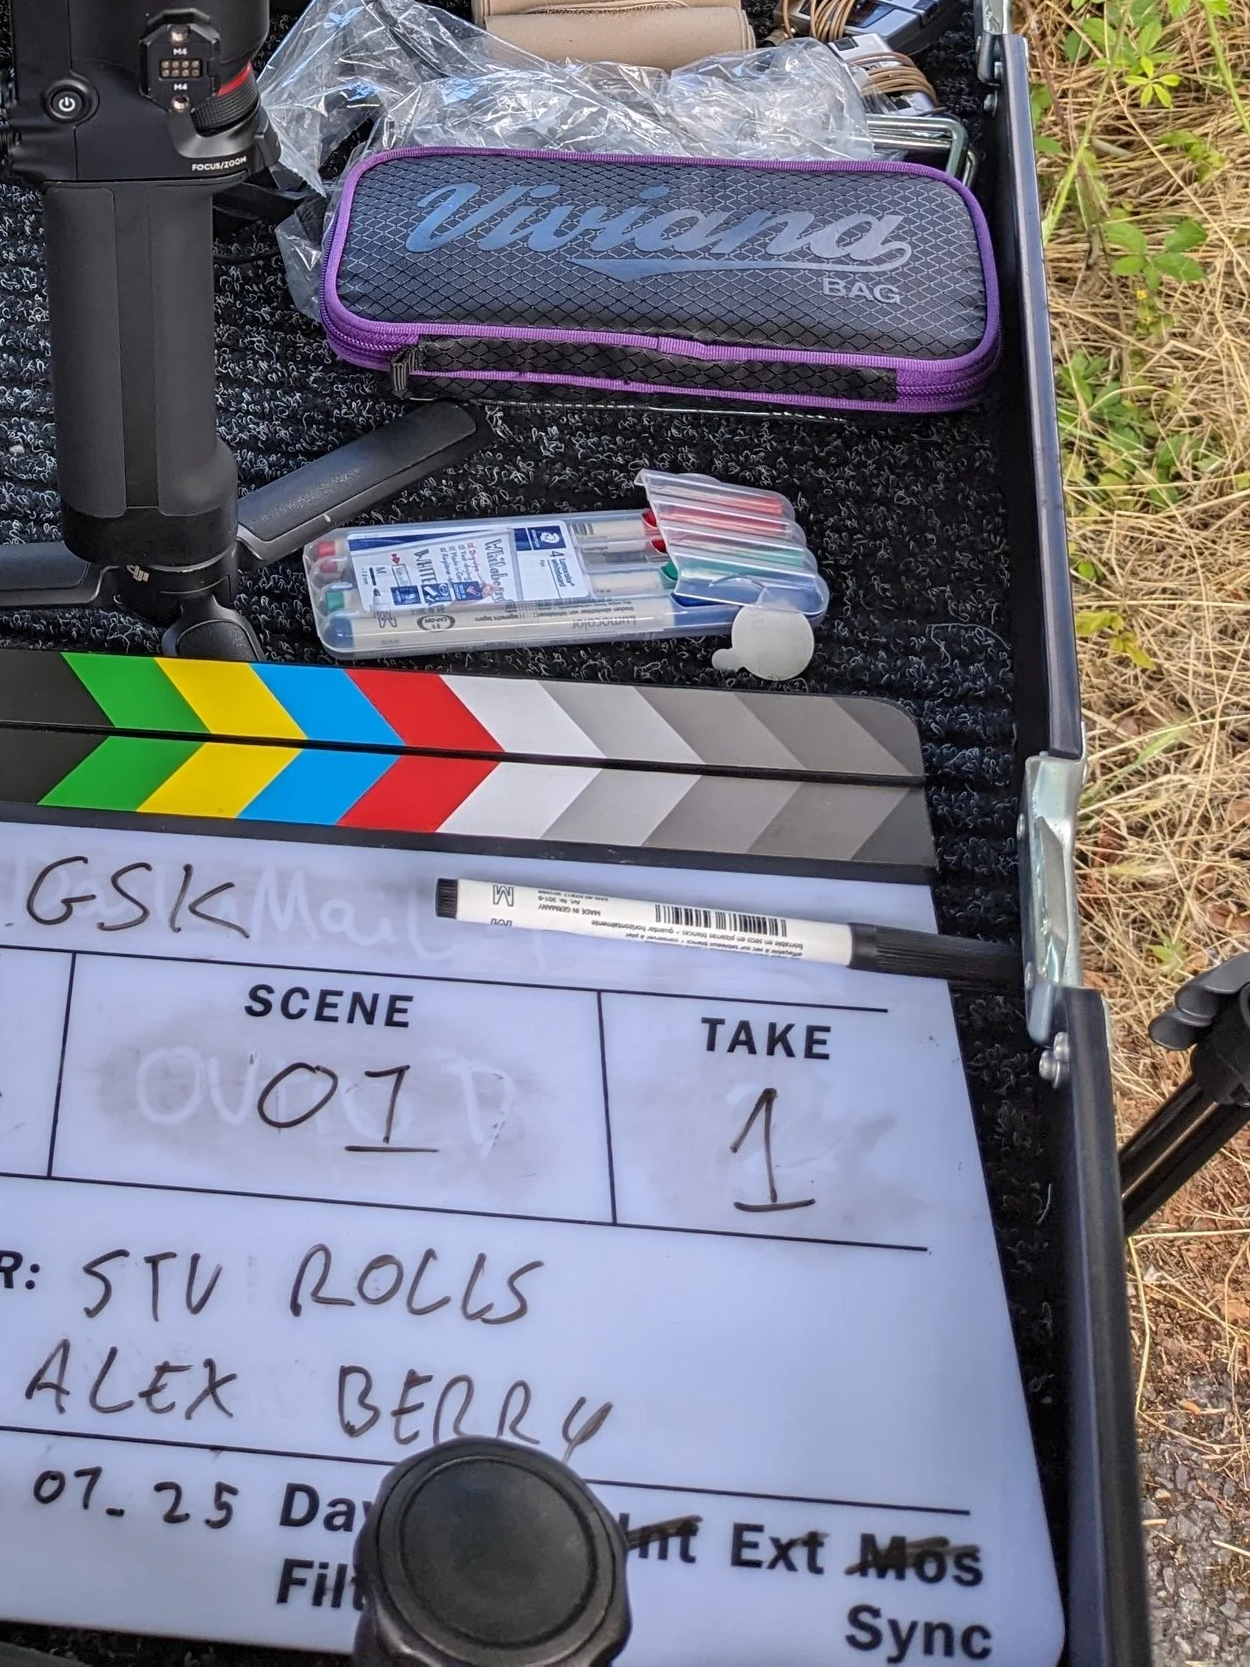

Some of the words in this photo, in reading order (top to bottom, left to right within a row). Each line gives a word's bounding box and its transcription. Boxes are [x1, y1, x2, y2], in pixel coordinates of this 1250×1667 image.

[173, 83, 188, 91] M4
[191, 155, 247, 172] FOCUS/ZOOM
[405, 182, 912, 271] Viviana
[821, 277, 902, 305] BAG
[571, 615, 636, 630] Lumocolor
[26, 855, 250, 939] GSK
[492, 885, 515, 907] M
[538, 903, 571, 914] GERMANY
[572, 906, 580, 914] IN
[582, 907, 601, 916] MADE
[591, 919, 646, 932] horizontalmente
[648, 926, 674, 935] guardar
[682, 929, 707, 940] blancas
[709, 933, 736, 943] pizarras
[747, 937, 763, 945] seco
[774, 939, 803, 951] borrable
[243, 984, 415, 1029] SCENE
[700, 1017, 832, 1060] TAKE
[257, 1060, 440, 1153] 01
[729, 1087, 816, 1213] 1
[289, 1243, 547, 1326] ROLLS
[24, 1337, 238, 1421] ALEX
[338, 1364, 615, 1464] BERRY
[729, 1522, 827, 1575] Ext
[845, 1602, 995, 1667] Sync
